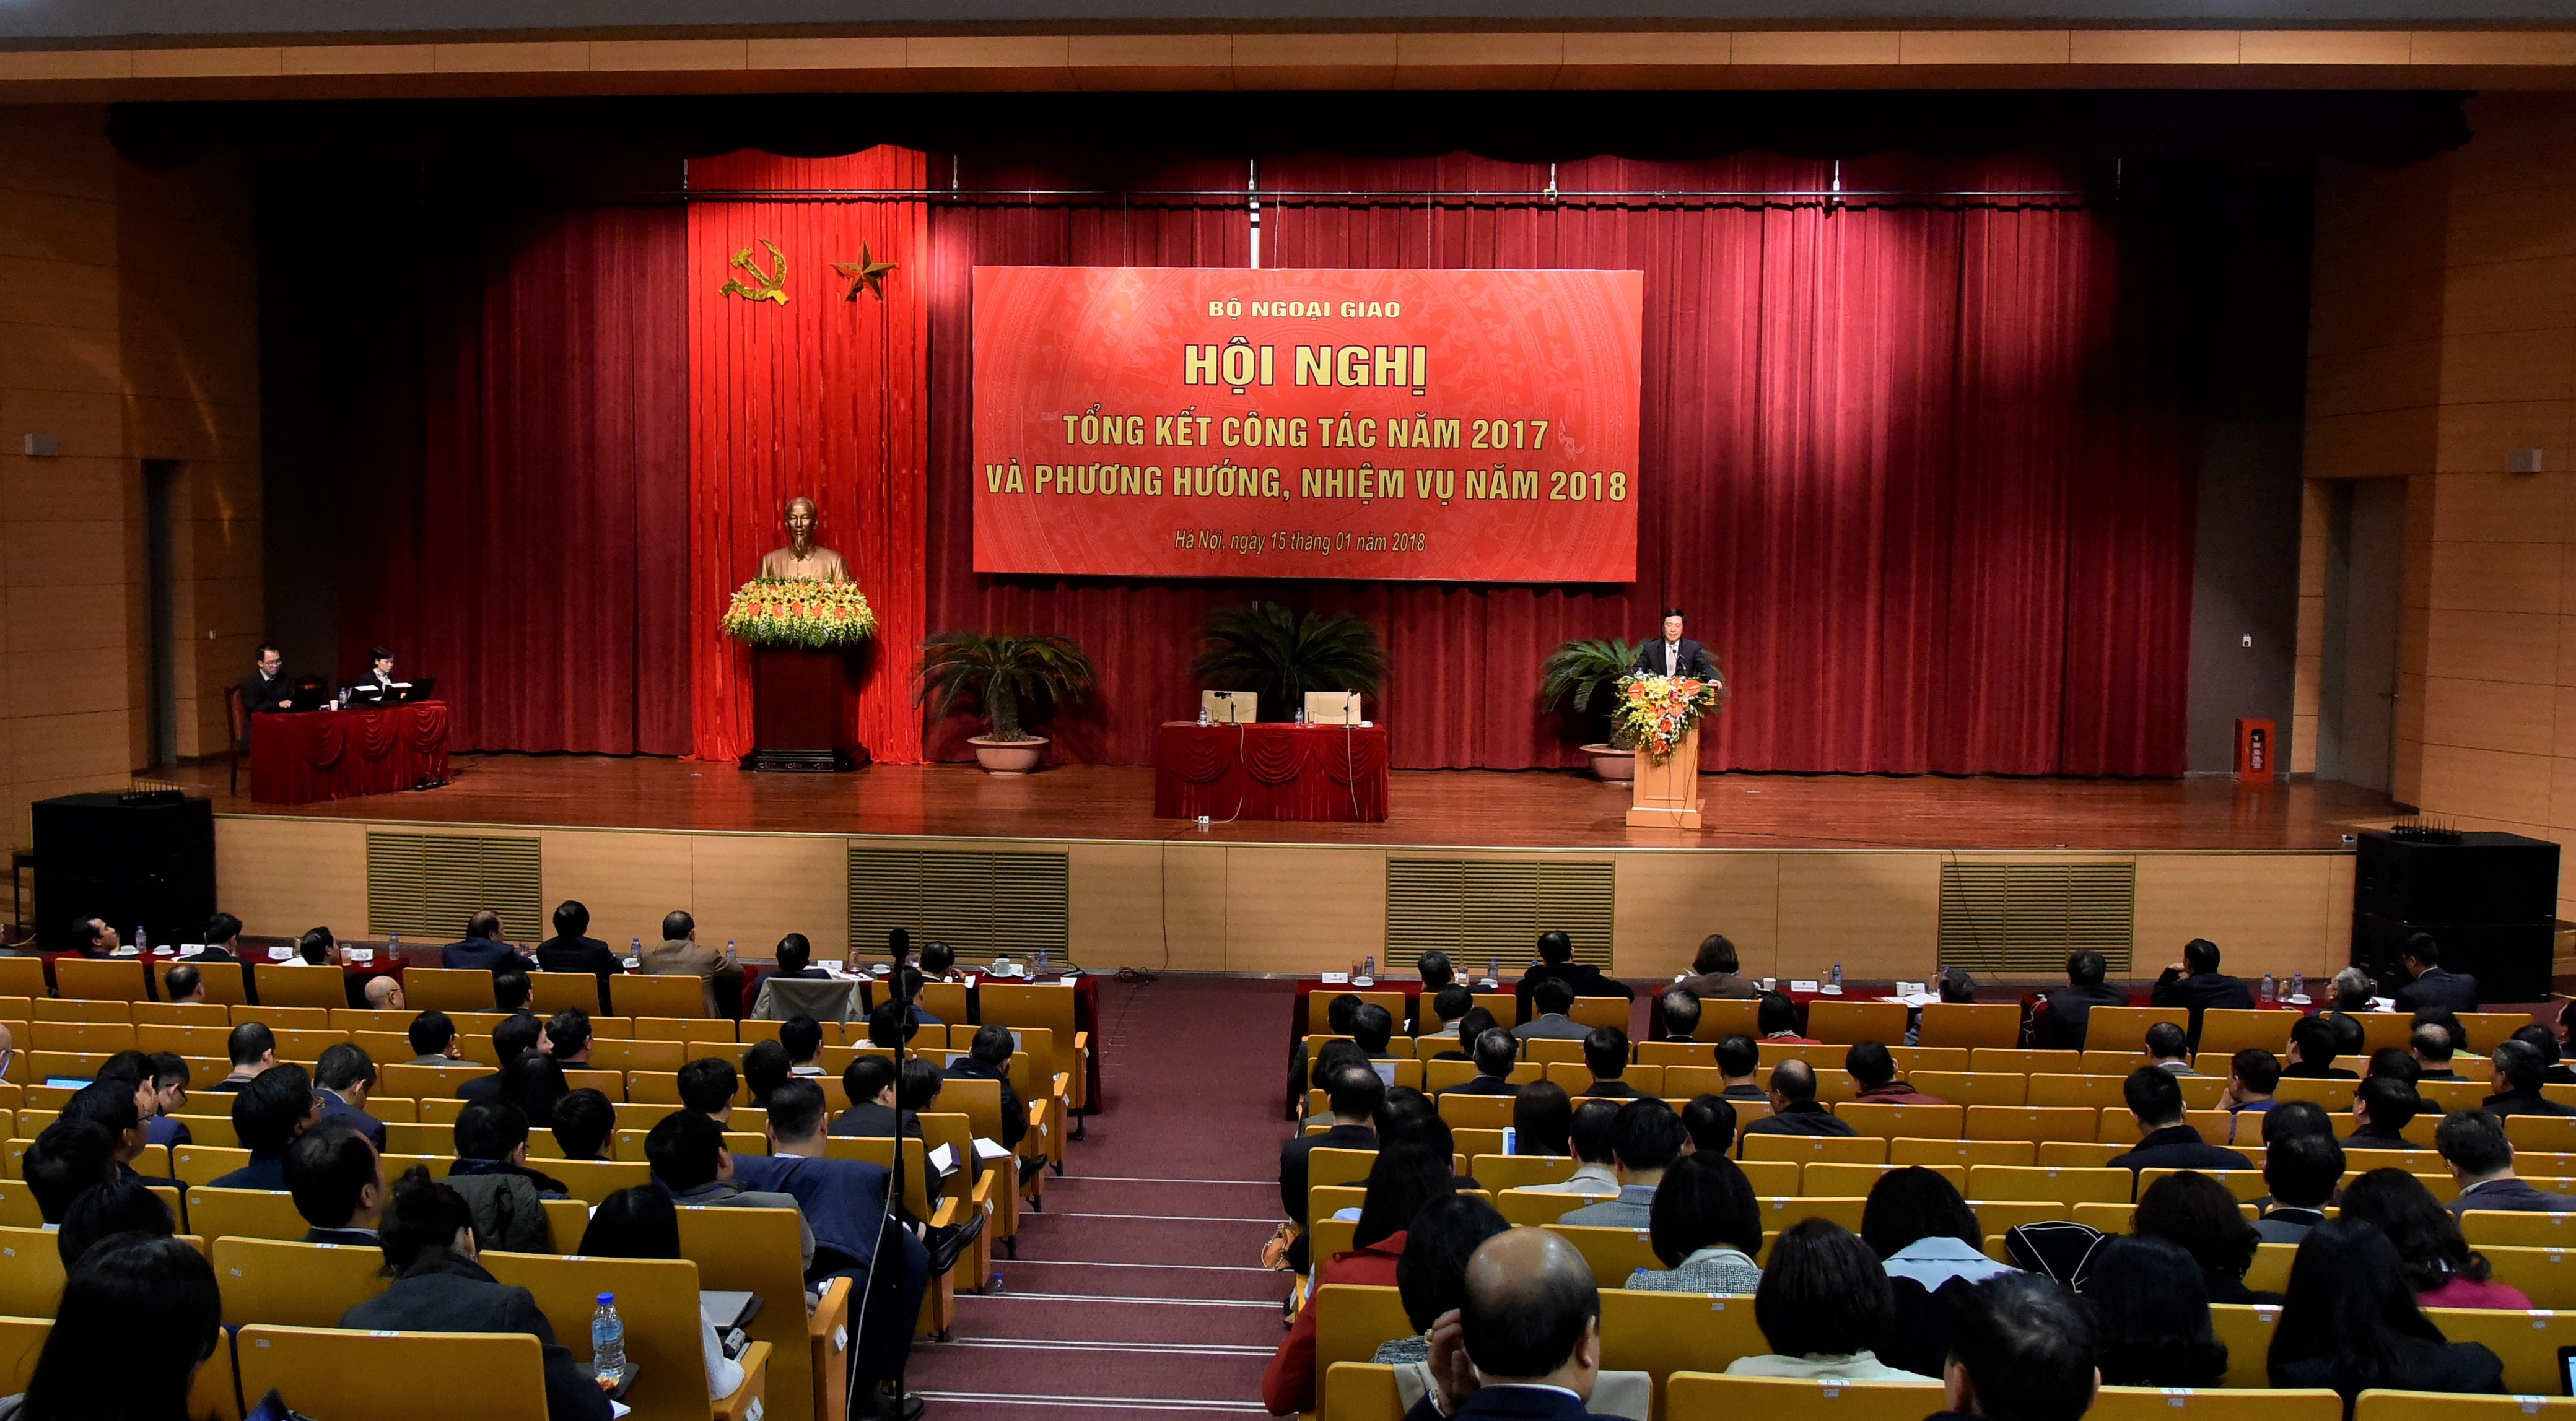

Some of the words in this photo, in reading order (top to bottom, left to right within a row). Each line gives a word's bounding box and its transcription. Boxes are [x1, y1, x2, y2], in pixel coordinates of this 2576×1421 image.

[1208, 298, 1242, 320] BỘ
[1251, 301, 1331, 321] NGOẠI
[1340, 301, 1401, 318] GIAO
[1184, 336, 1274, 394] HỘI
[1295, 345, 1426, 396] NGHỊ
[1063, 403, 1145, 446] TỔNG
[1155, 406, 1212, 446] KẾT
[1221, 411, 1308, 448] CÔNG
[1317, 411, 1377, 448] TÁC
[1387, 412, 1461, 449] NĂM
[1470, 419, 1549, 450] 2017
[985, 458, 1025, 494] VÀ
[1034, 463, 1163, 496] PHƯƠNG
[1172, 458, 1290, 501] HƯỚNG,
[1301, 463, 1405, 505] NHIỆM
[1415, 469, 1455, 506] VỤ
[1465, 463, 1540, 500] NĂM
[1548, 470, 1627, 502] 2018
[1175, 528, 1194, 549] Hà
[1198, 529, 1226, 554] Nội,
[1230, 530, 1265, 555] ngày
[1270, 531, 1286, 550] 15
[1290, 529, 1331, 556] tháng
[1335, 531, 1353, 552] 01
[1356, 532, 1387, 552] năm
[1392, 532, 1425, 552] 2018
